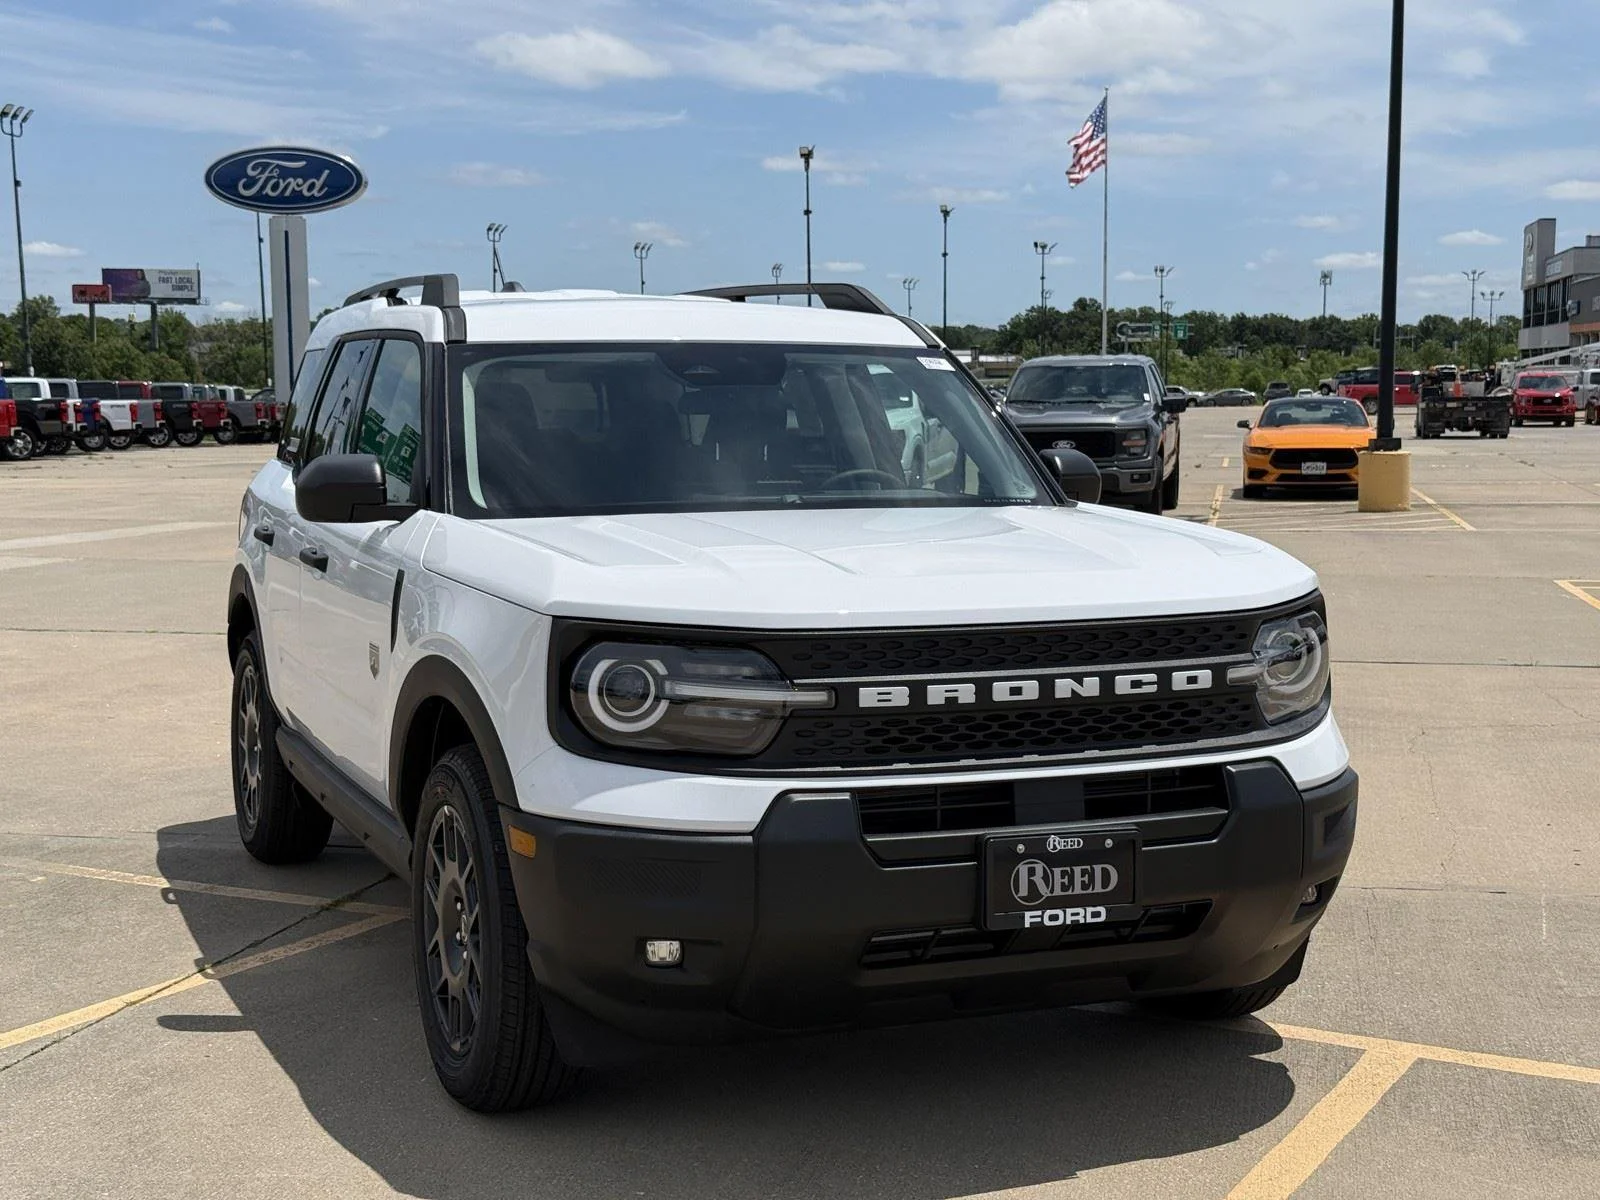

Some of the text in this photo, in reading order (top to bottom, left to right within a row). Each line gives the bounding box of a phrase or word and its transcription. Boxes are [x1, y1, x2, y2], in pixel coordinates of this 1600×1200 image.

[238, 159, 330, 197] Ford
[859, 669, 1213, 708] BRONCO
[1024, 906, 1107, 928] FORD
